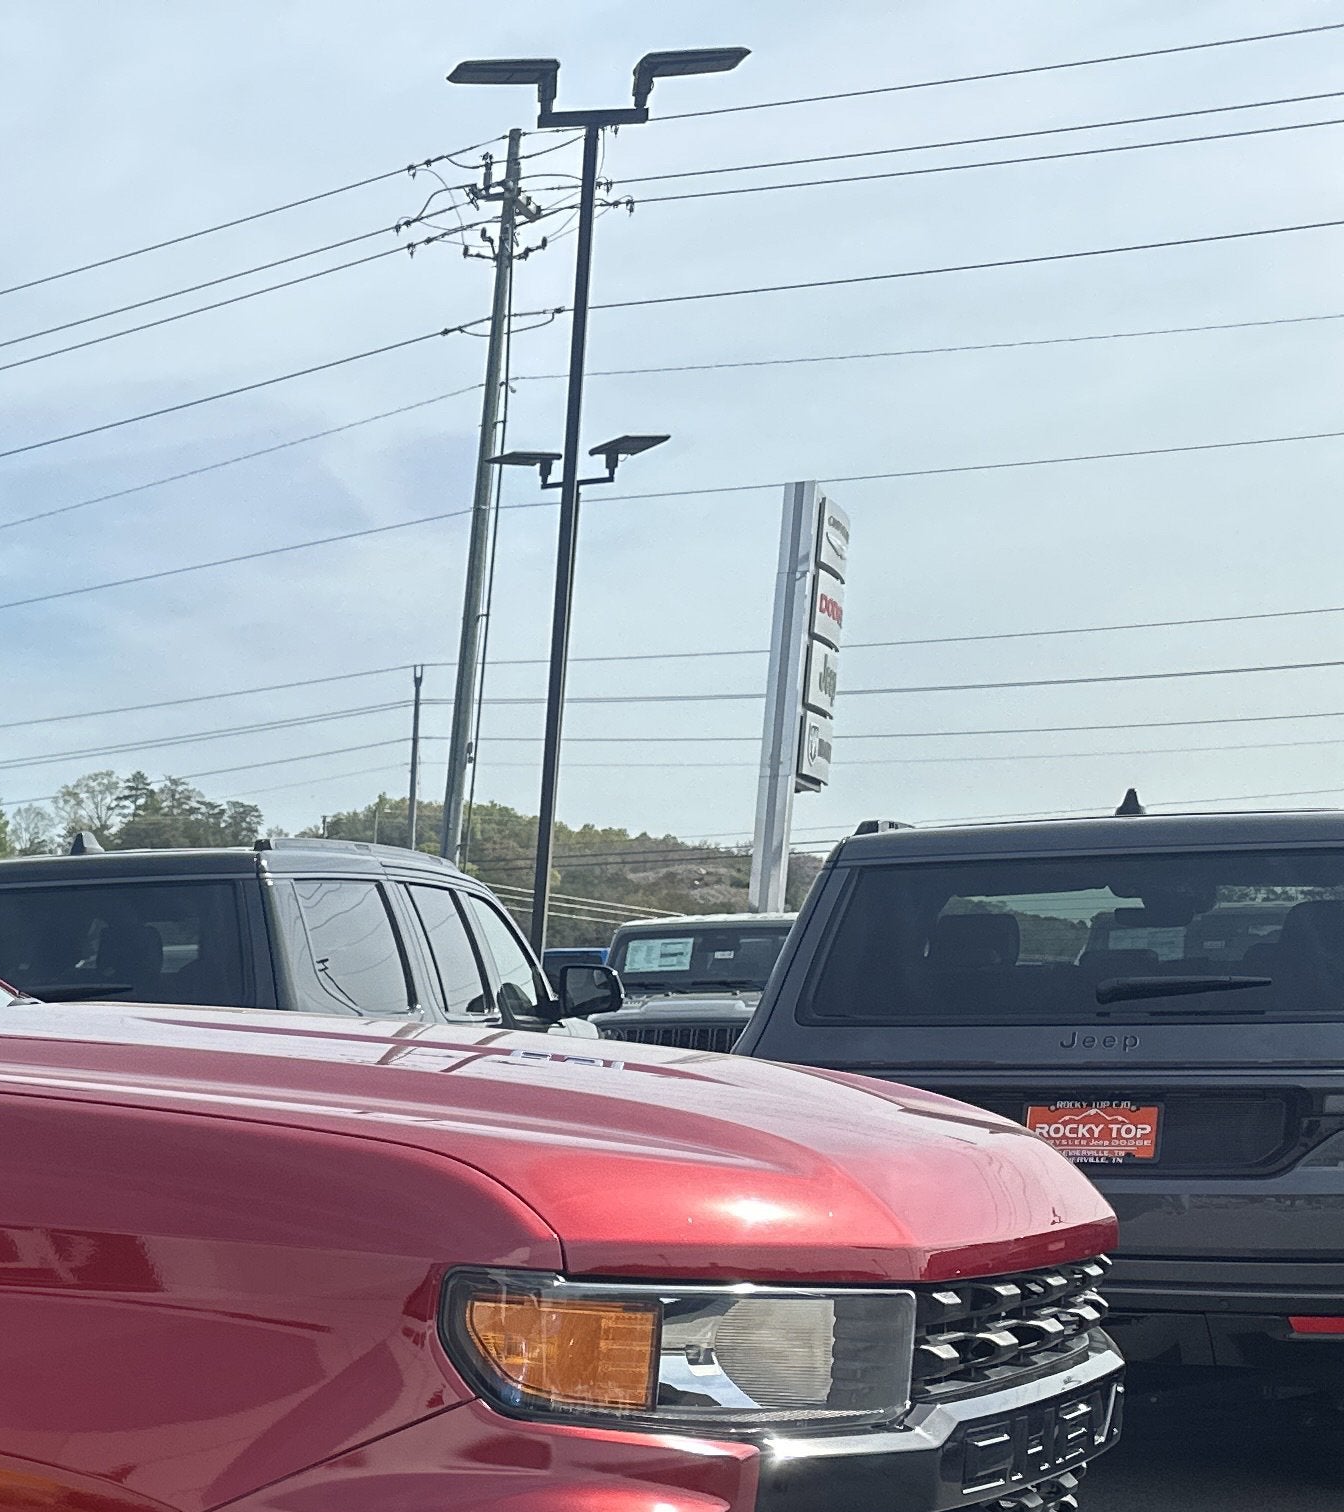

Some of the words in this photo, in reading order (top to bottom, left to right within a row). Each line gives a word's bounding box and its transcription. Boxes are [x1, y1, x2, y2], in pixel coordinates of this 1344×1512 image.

[1059, 1031, 1140, 1053] Jeep
[1056, 1100, 1088, 1109] ROCKY
[1035, 1123, 1105, 1138] ROCKY
[1109, 1124, 1152, 1139] TOP
[1089, 1138, 1110, 1147] Jeep
